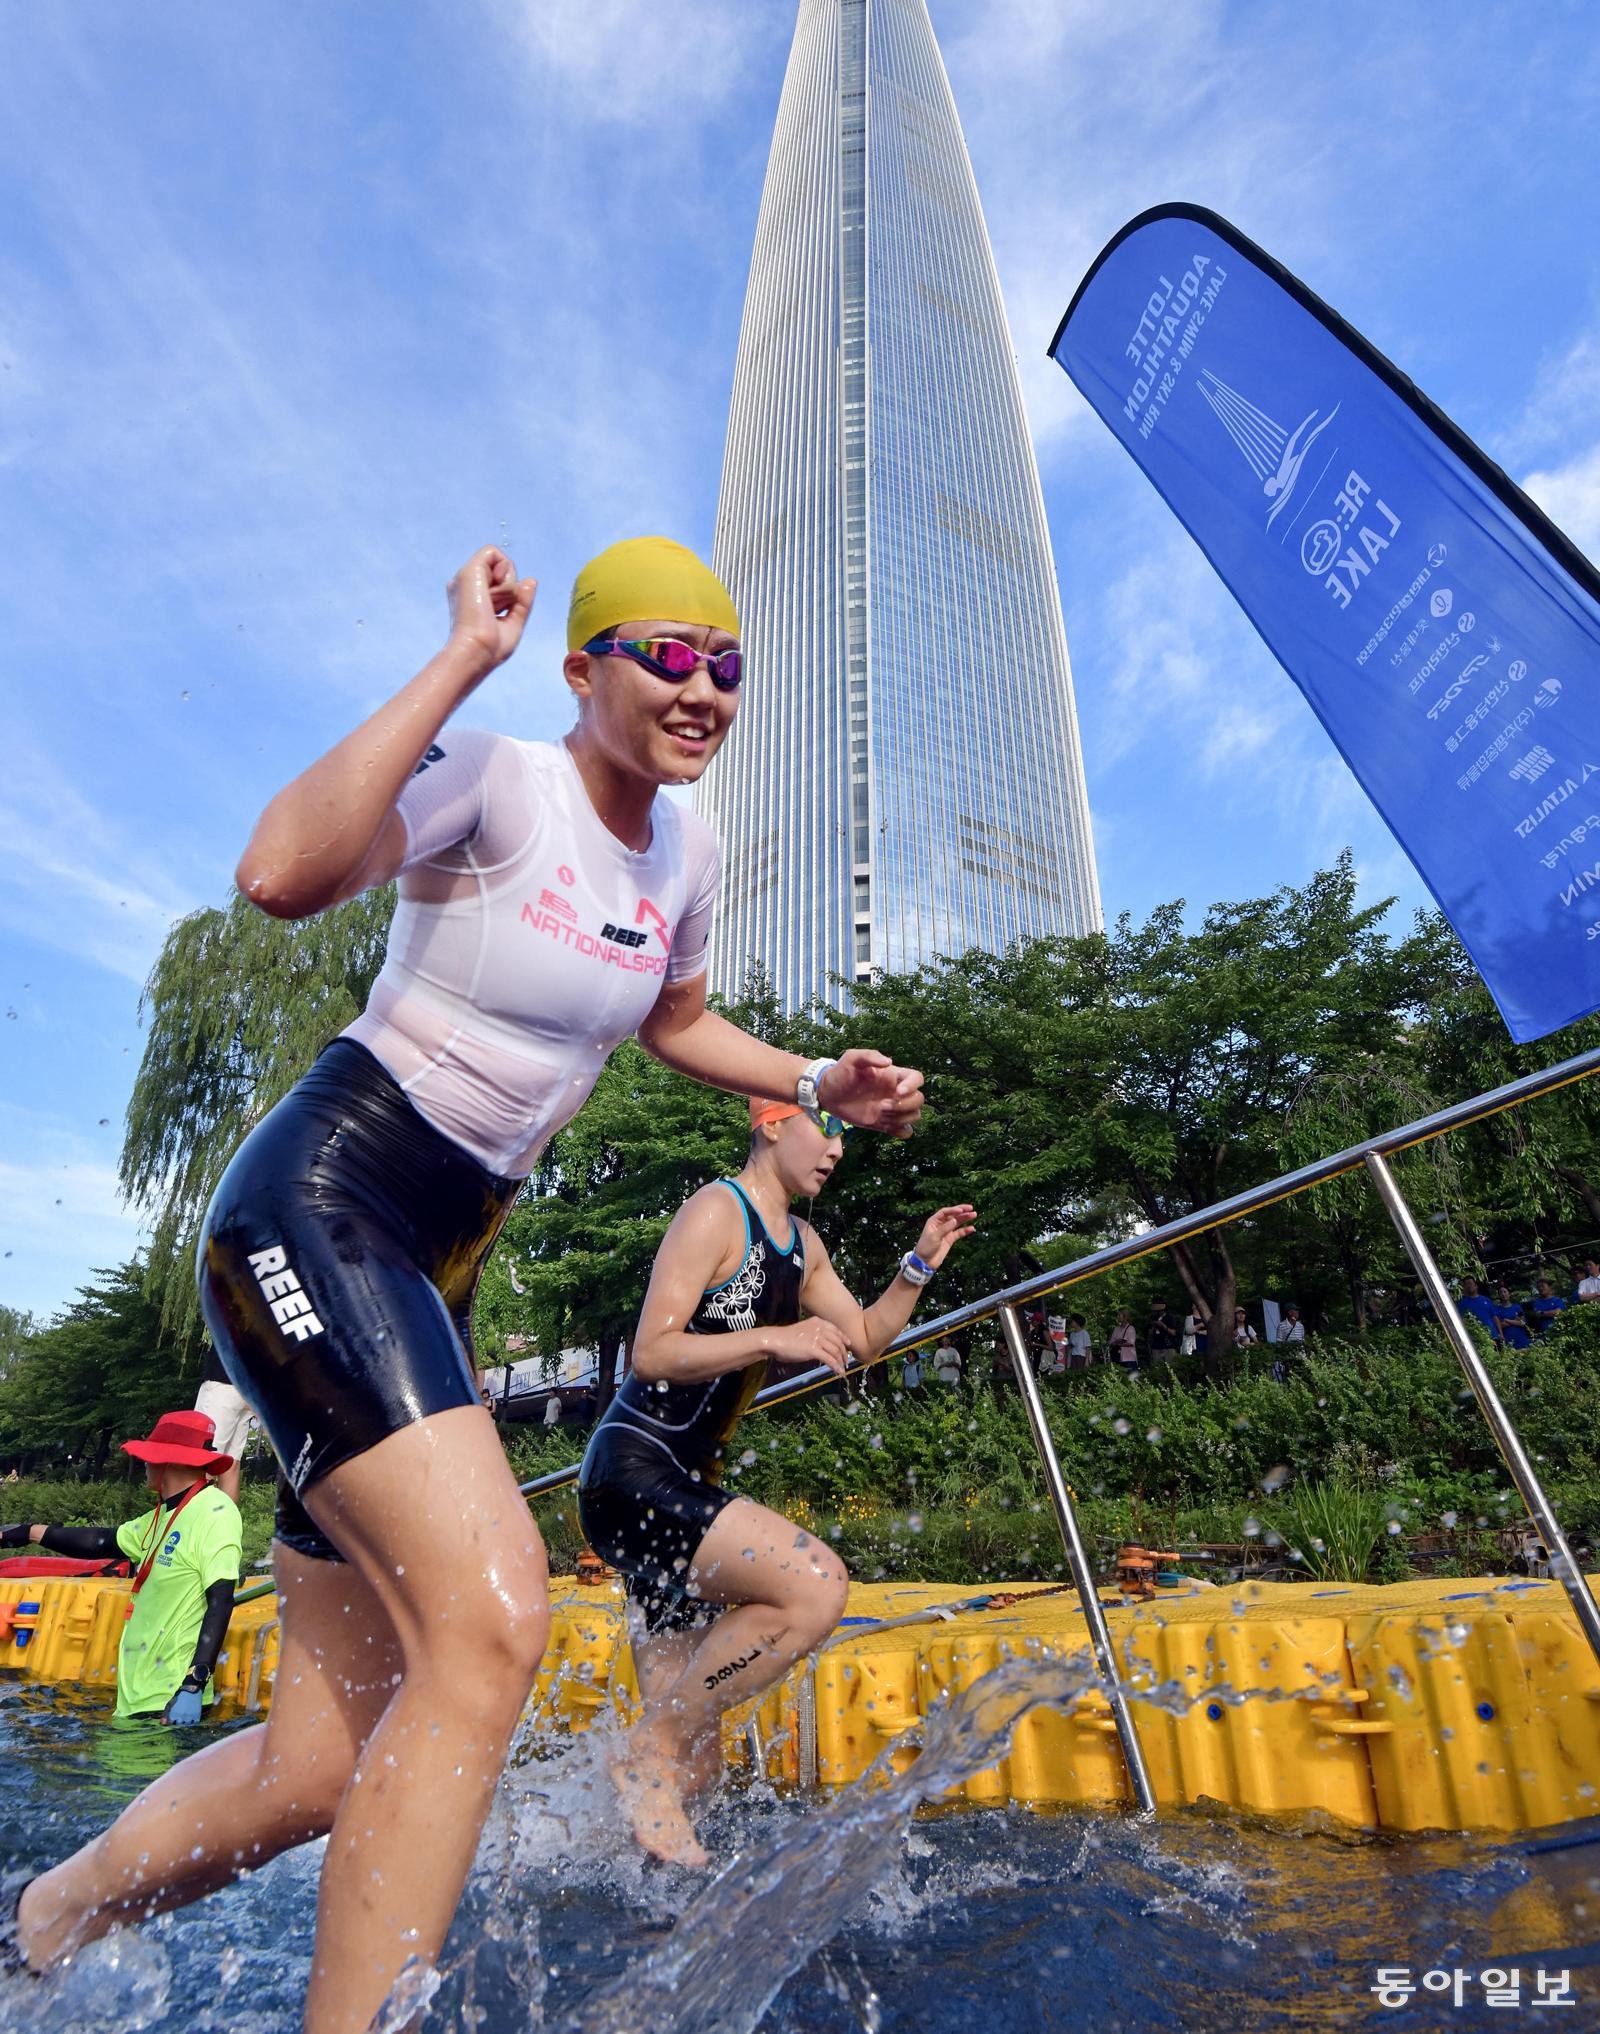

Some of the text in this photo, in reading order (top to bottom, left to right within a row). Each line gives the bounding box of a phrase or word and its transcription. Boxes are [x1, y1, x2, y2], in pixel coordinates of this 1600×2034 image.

[600, 923, 648, 948] REEF
[247, 1245, 325, 1341] REEF
[704, 1650, 762, 1690] 1286
